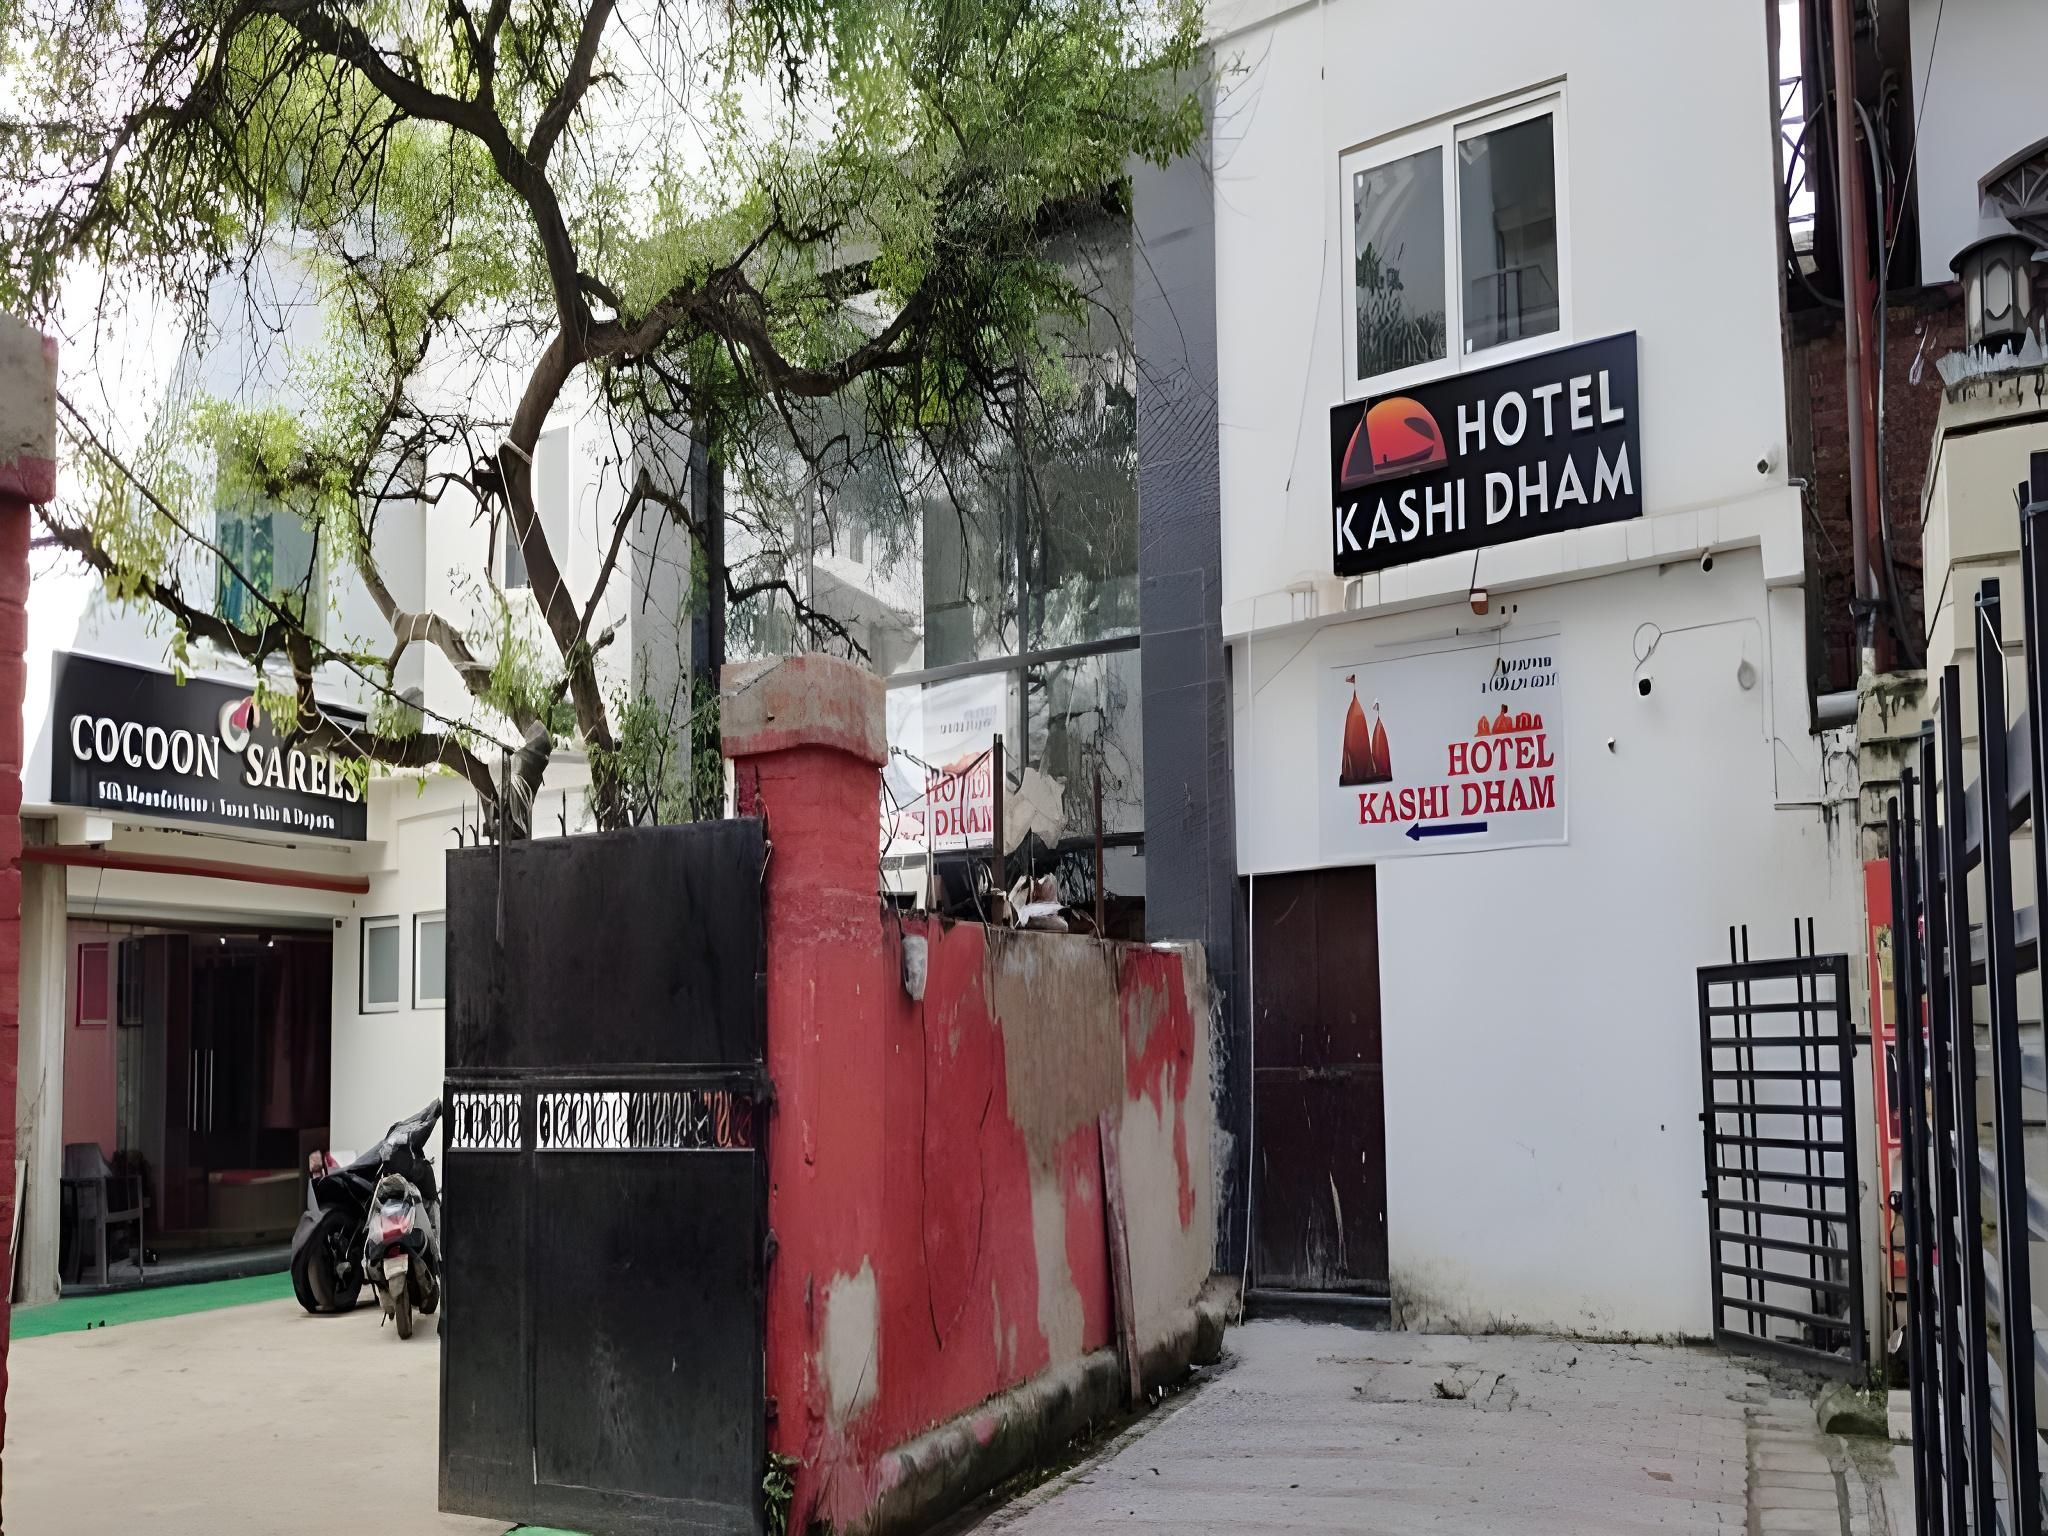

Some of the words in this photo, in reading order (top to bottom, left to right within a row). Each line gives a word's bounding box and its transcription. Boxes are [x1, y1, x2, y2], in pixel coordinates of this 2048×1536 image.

[1457, 370, 1624, 455] HOTEL
[1336, 478, 1465, 555] KASHI
[1486, 440, 1634, 525] DHAM
[71, 714, 219, 780] COCOON
[1448, 733, 1555, 776] HOTEL
[1358, 784, 1449, 825] KASHI
[1461, 774, 1556, 816] DHAM
